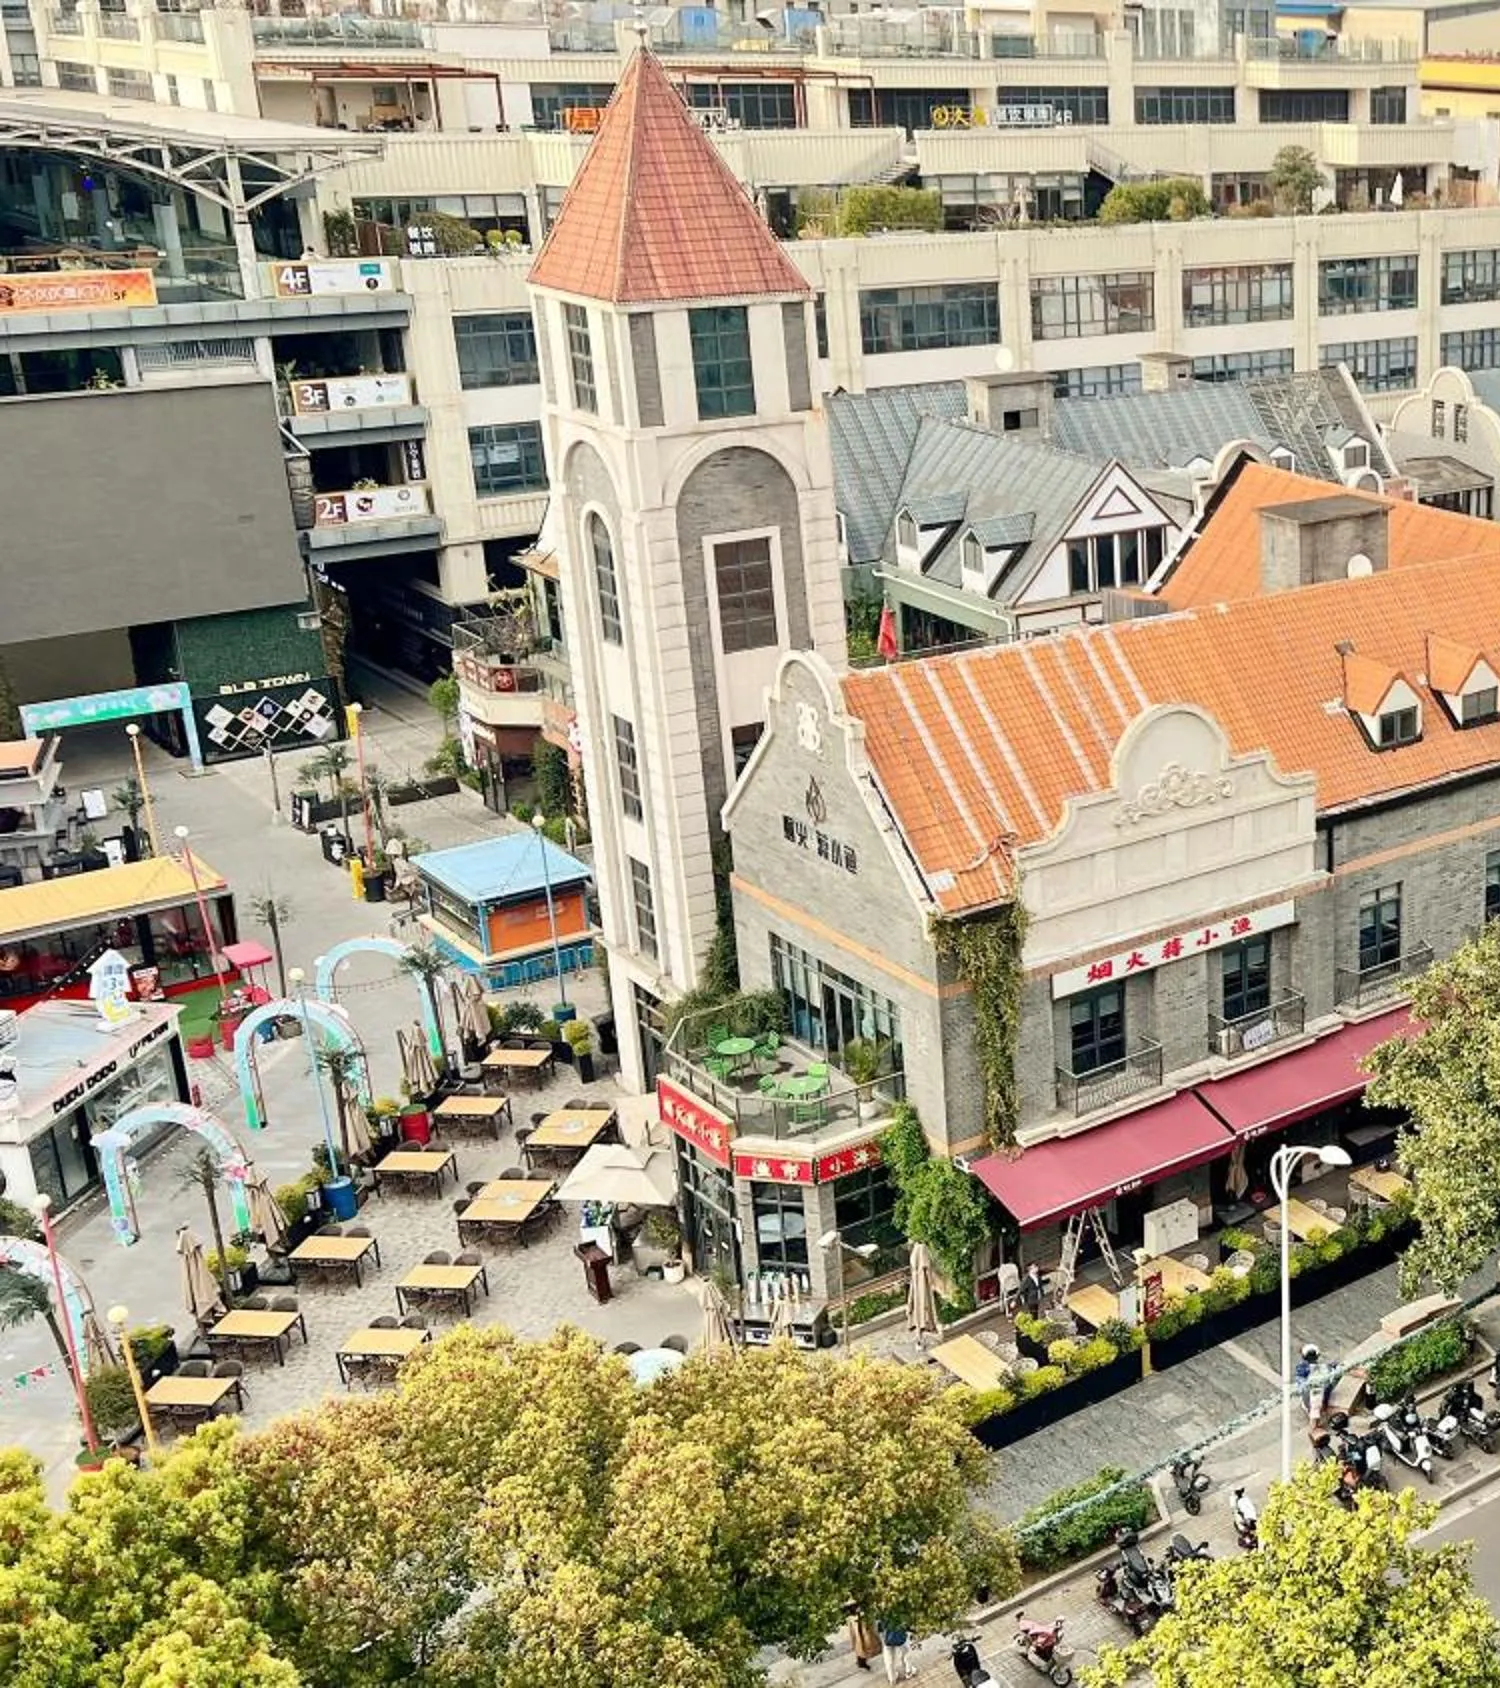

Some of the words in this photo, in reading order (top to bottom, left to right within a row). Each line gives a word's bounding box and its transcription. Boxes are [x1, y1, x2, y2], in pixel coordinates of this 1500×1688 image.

[280, 267, 309, 291] 4F
[299, 384, 325, 406] 3F
[319, 498, 343, 519] 2F
[259, 671, 311, 689] TOWN
